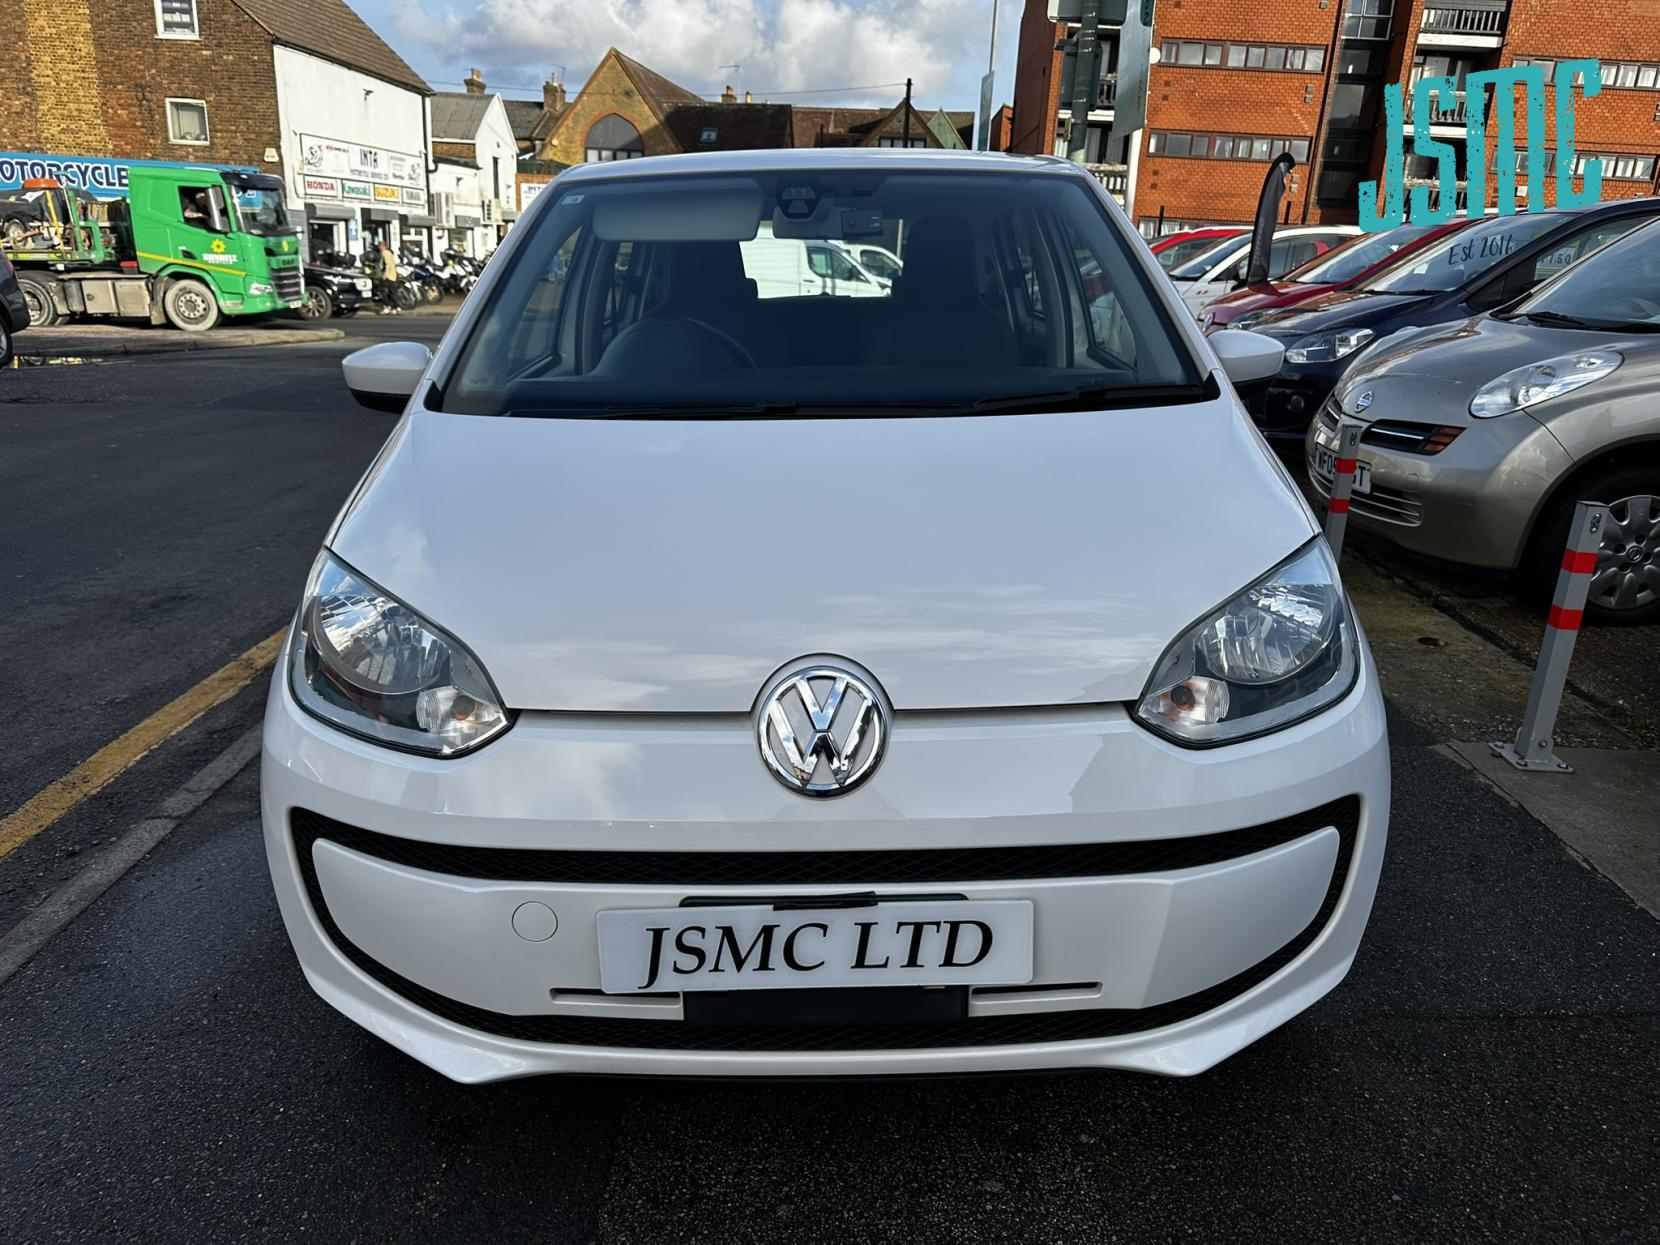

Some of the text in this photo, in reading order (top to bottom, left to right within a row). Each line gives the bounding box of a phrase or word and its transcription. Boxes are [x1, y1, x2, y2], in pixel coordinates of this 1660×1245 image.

[306, 180, 335, 192] HONDA
[638, 920, 994, 990] JSMC LTD
